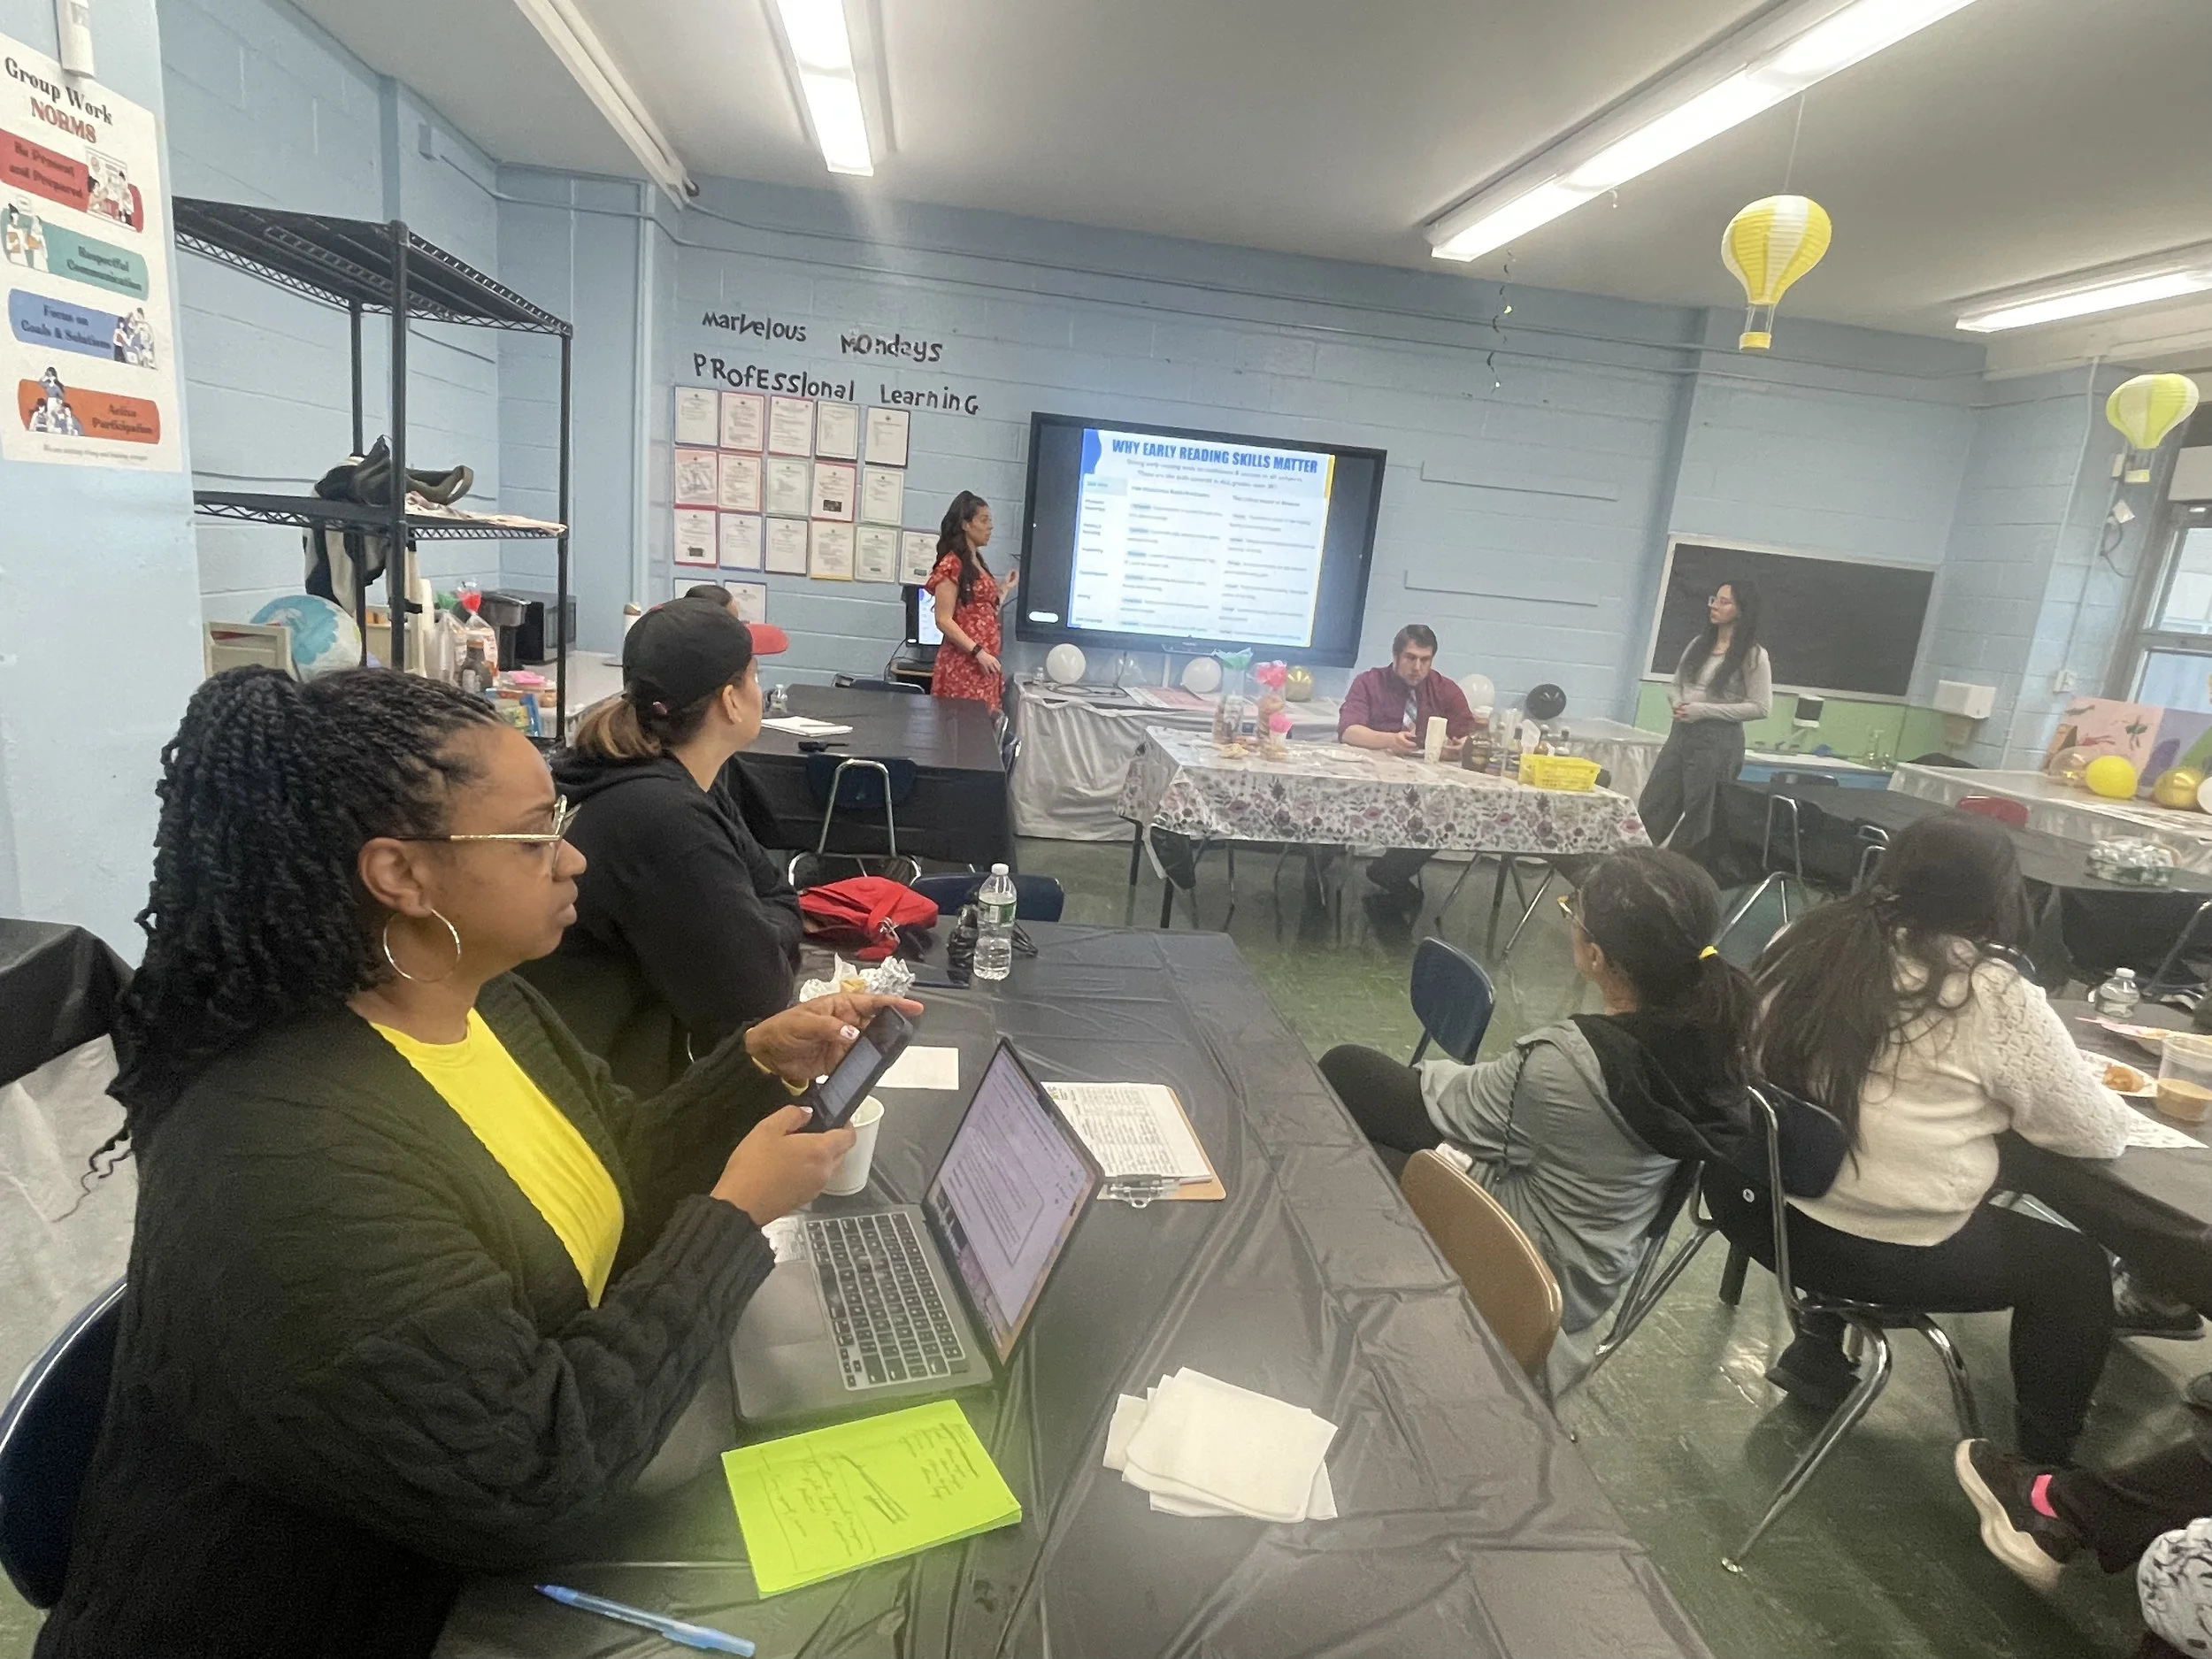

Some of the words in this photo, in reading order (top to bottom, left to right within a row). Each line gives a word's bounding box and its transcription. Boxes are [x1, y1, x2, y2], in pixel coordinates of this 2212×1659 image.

[5, 57, 61, 104] Group
[65, 86, 113, 126] Work
[30, 96, 96, 143] NORMS
[1112, 439, 1141, 455] WHY
[1143, 442, 1177, 458] EARLY
[1179, 446, 1230, 465] READING
[1233, 452, 1271, 469] SKILLS
[1273, 457, 1318, 474] MATTER
